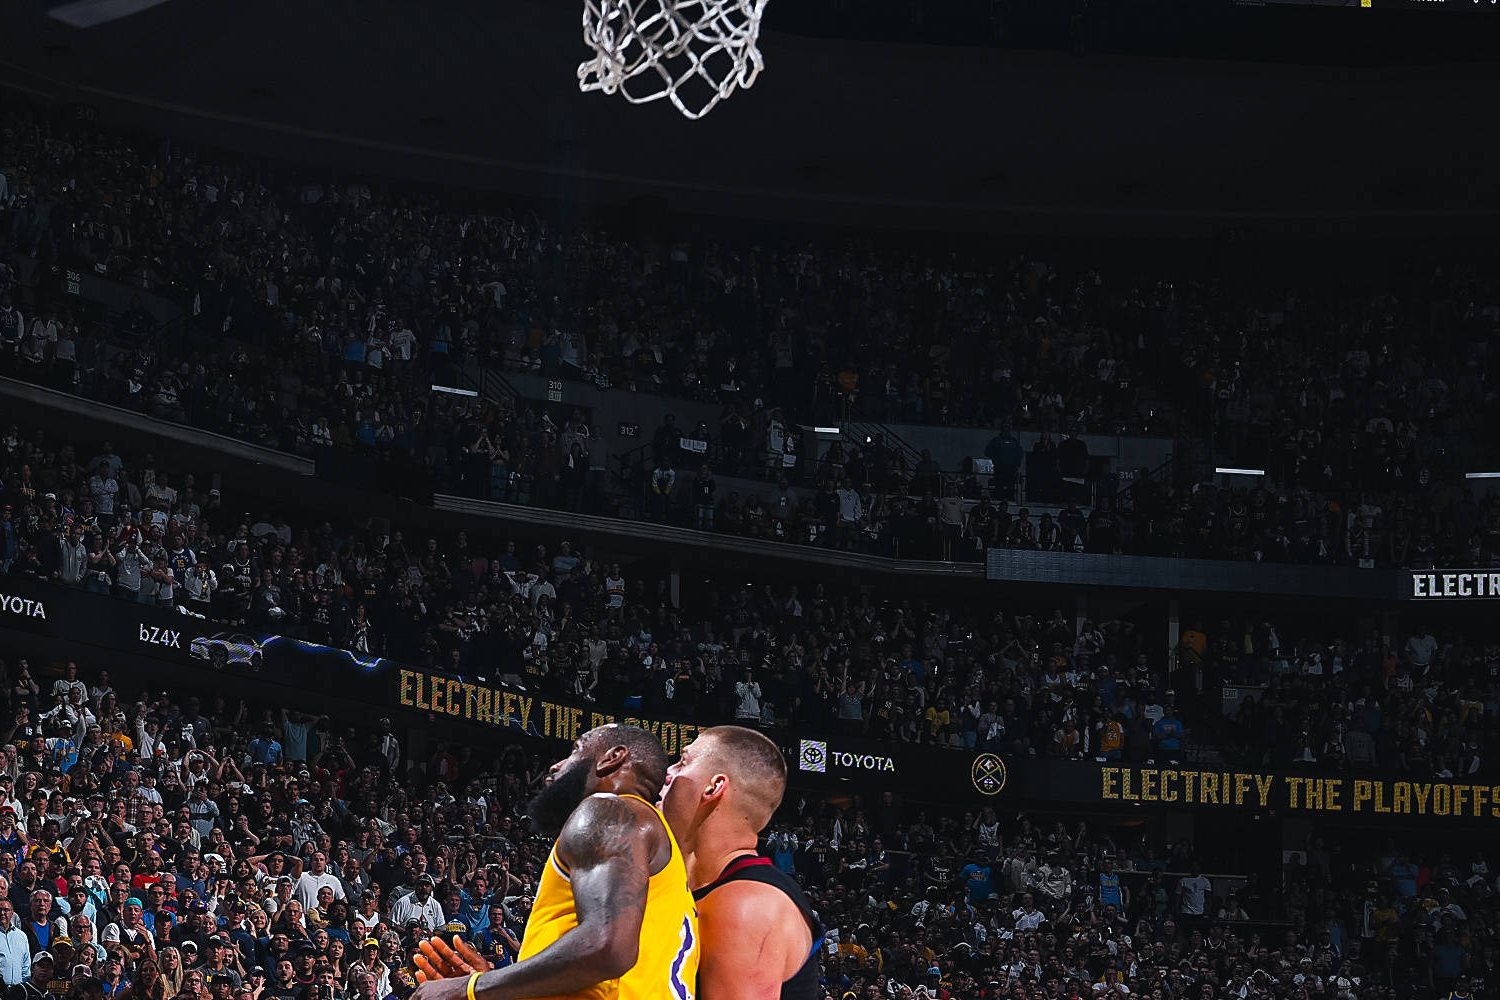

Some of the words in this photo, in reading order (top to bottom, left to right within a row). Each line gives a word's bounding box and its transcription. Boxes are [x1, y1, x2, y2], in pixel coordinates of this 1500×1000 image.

[547, 381, 563, 391] 310
[139, 623, 181, 650] bZ4X
[399, 668, 532, 736] ELECTRIFY
[541, 701, 583, 741] THE
[832, 751, 895, 773] TOYOTA
[1101, 767, 1275, 806] ELECTRIFY
[1285, 777, 1342, 811] THE
